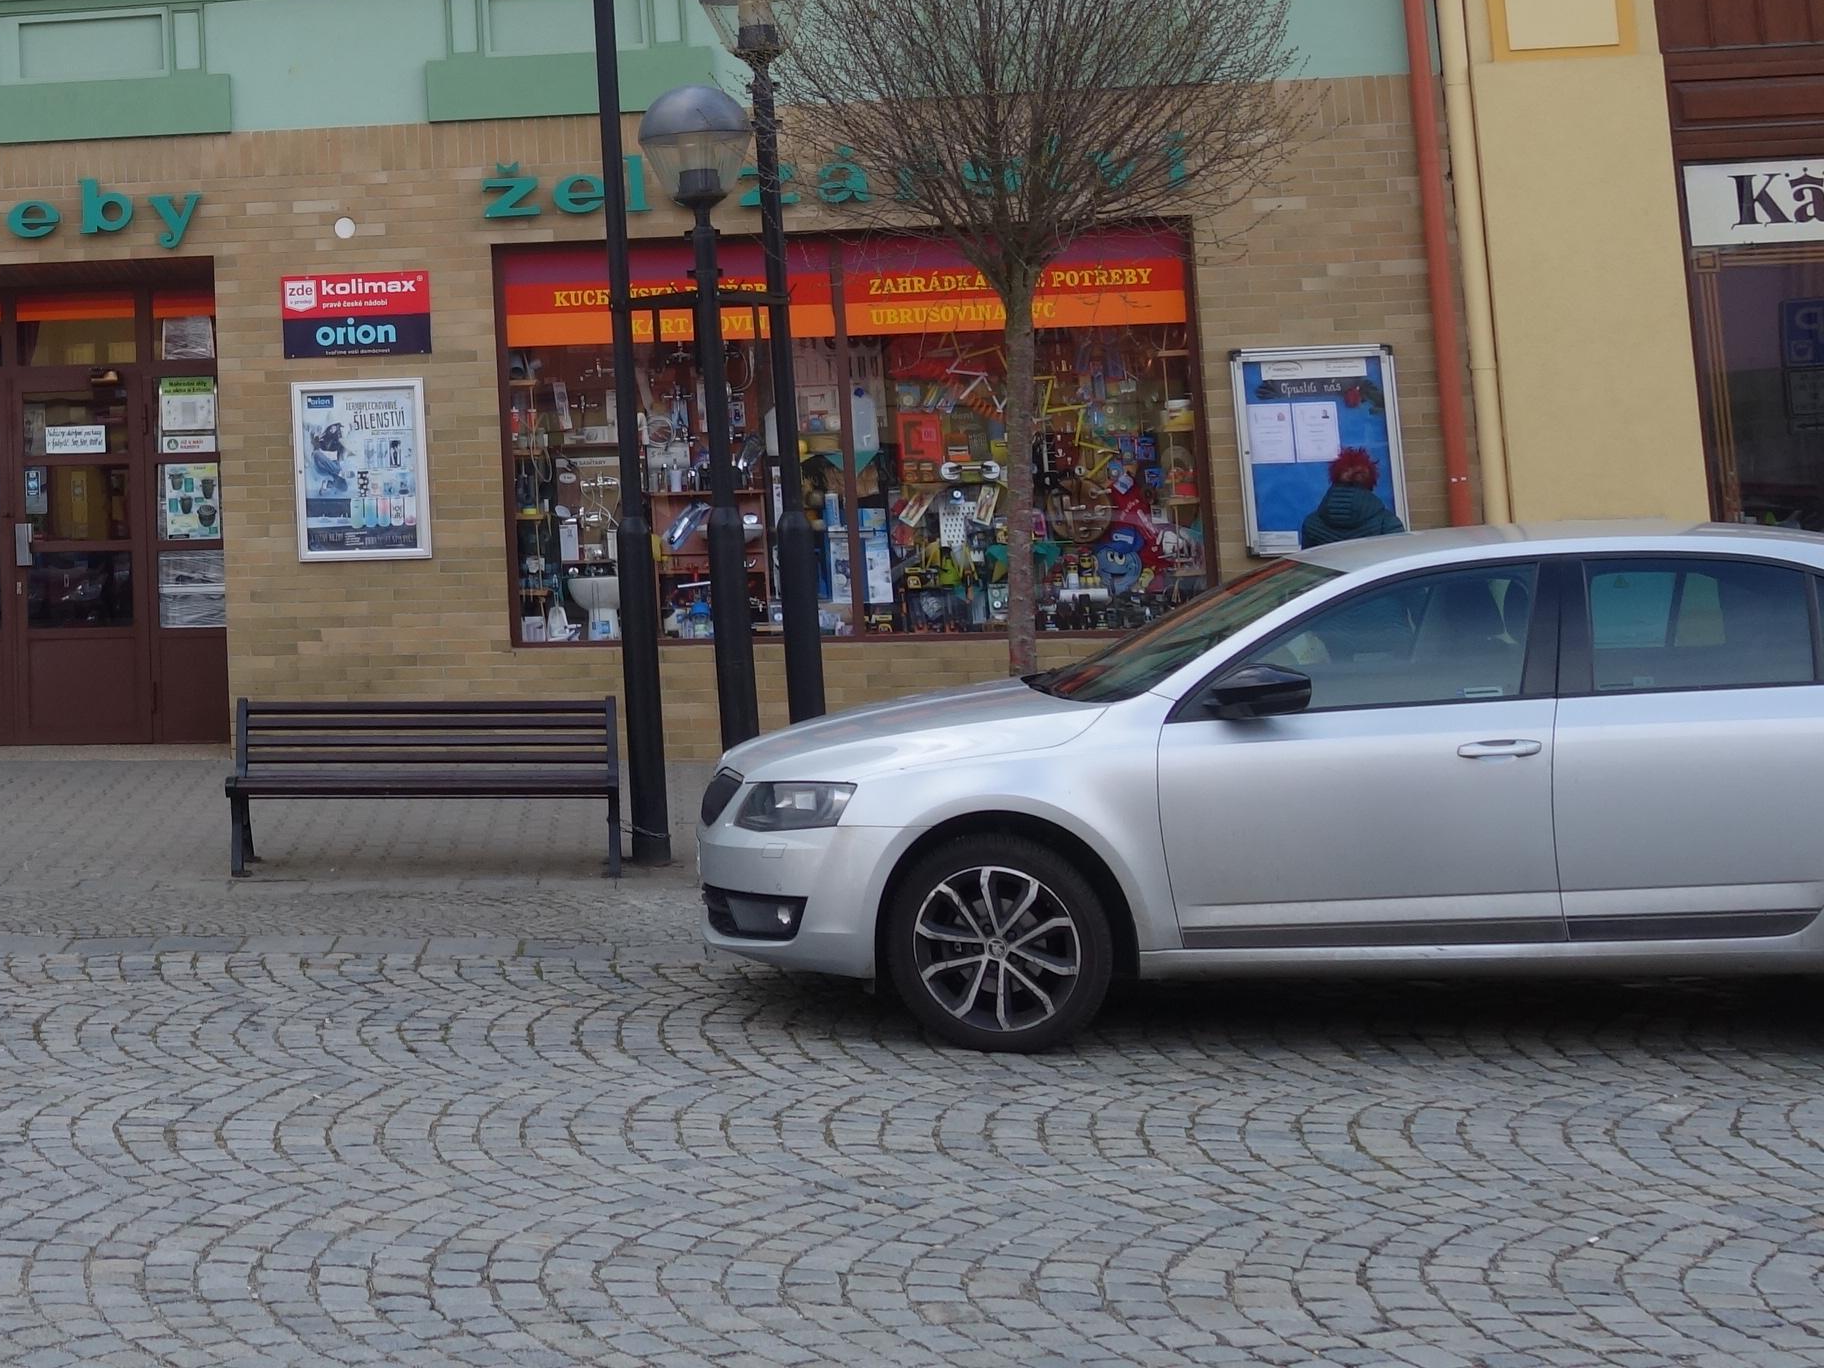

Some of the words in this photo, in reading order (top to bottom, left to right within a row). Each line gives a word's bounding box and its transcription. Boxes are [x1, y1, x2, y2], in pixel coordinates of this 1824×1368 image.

[321, 279, 416, 296] kolimax
[1051, 266, 1153, 288] POTŘEBY
[289, 284, 313, 297] zde
[316, 317, 397, 346] orion
[1281, 381, 1317, 398] Opustili
[1324, 378, 1342, 392] nás
[353, 407, 406, 431] ŠÍLENSTVÍ
